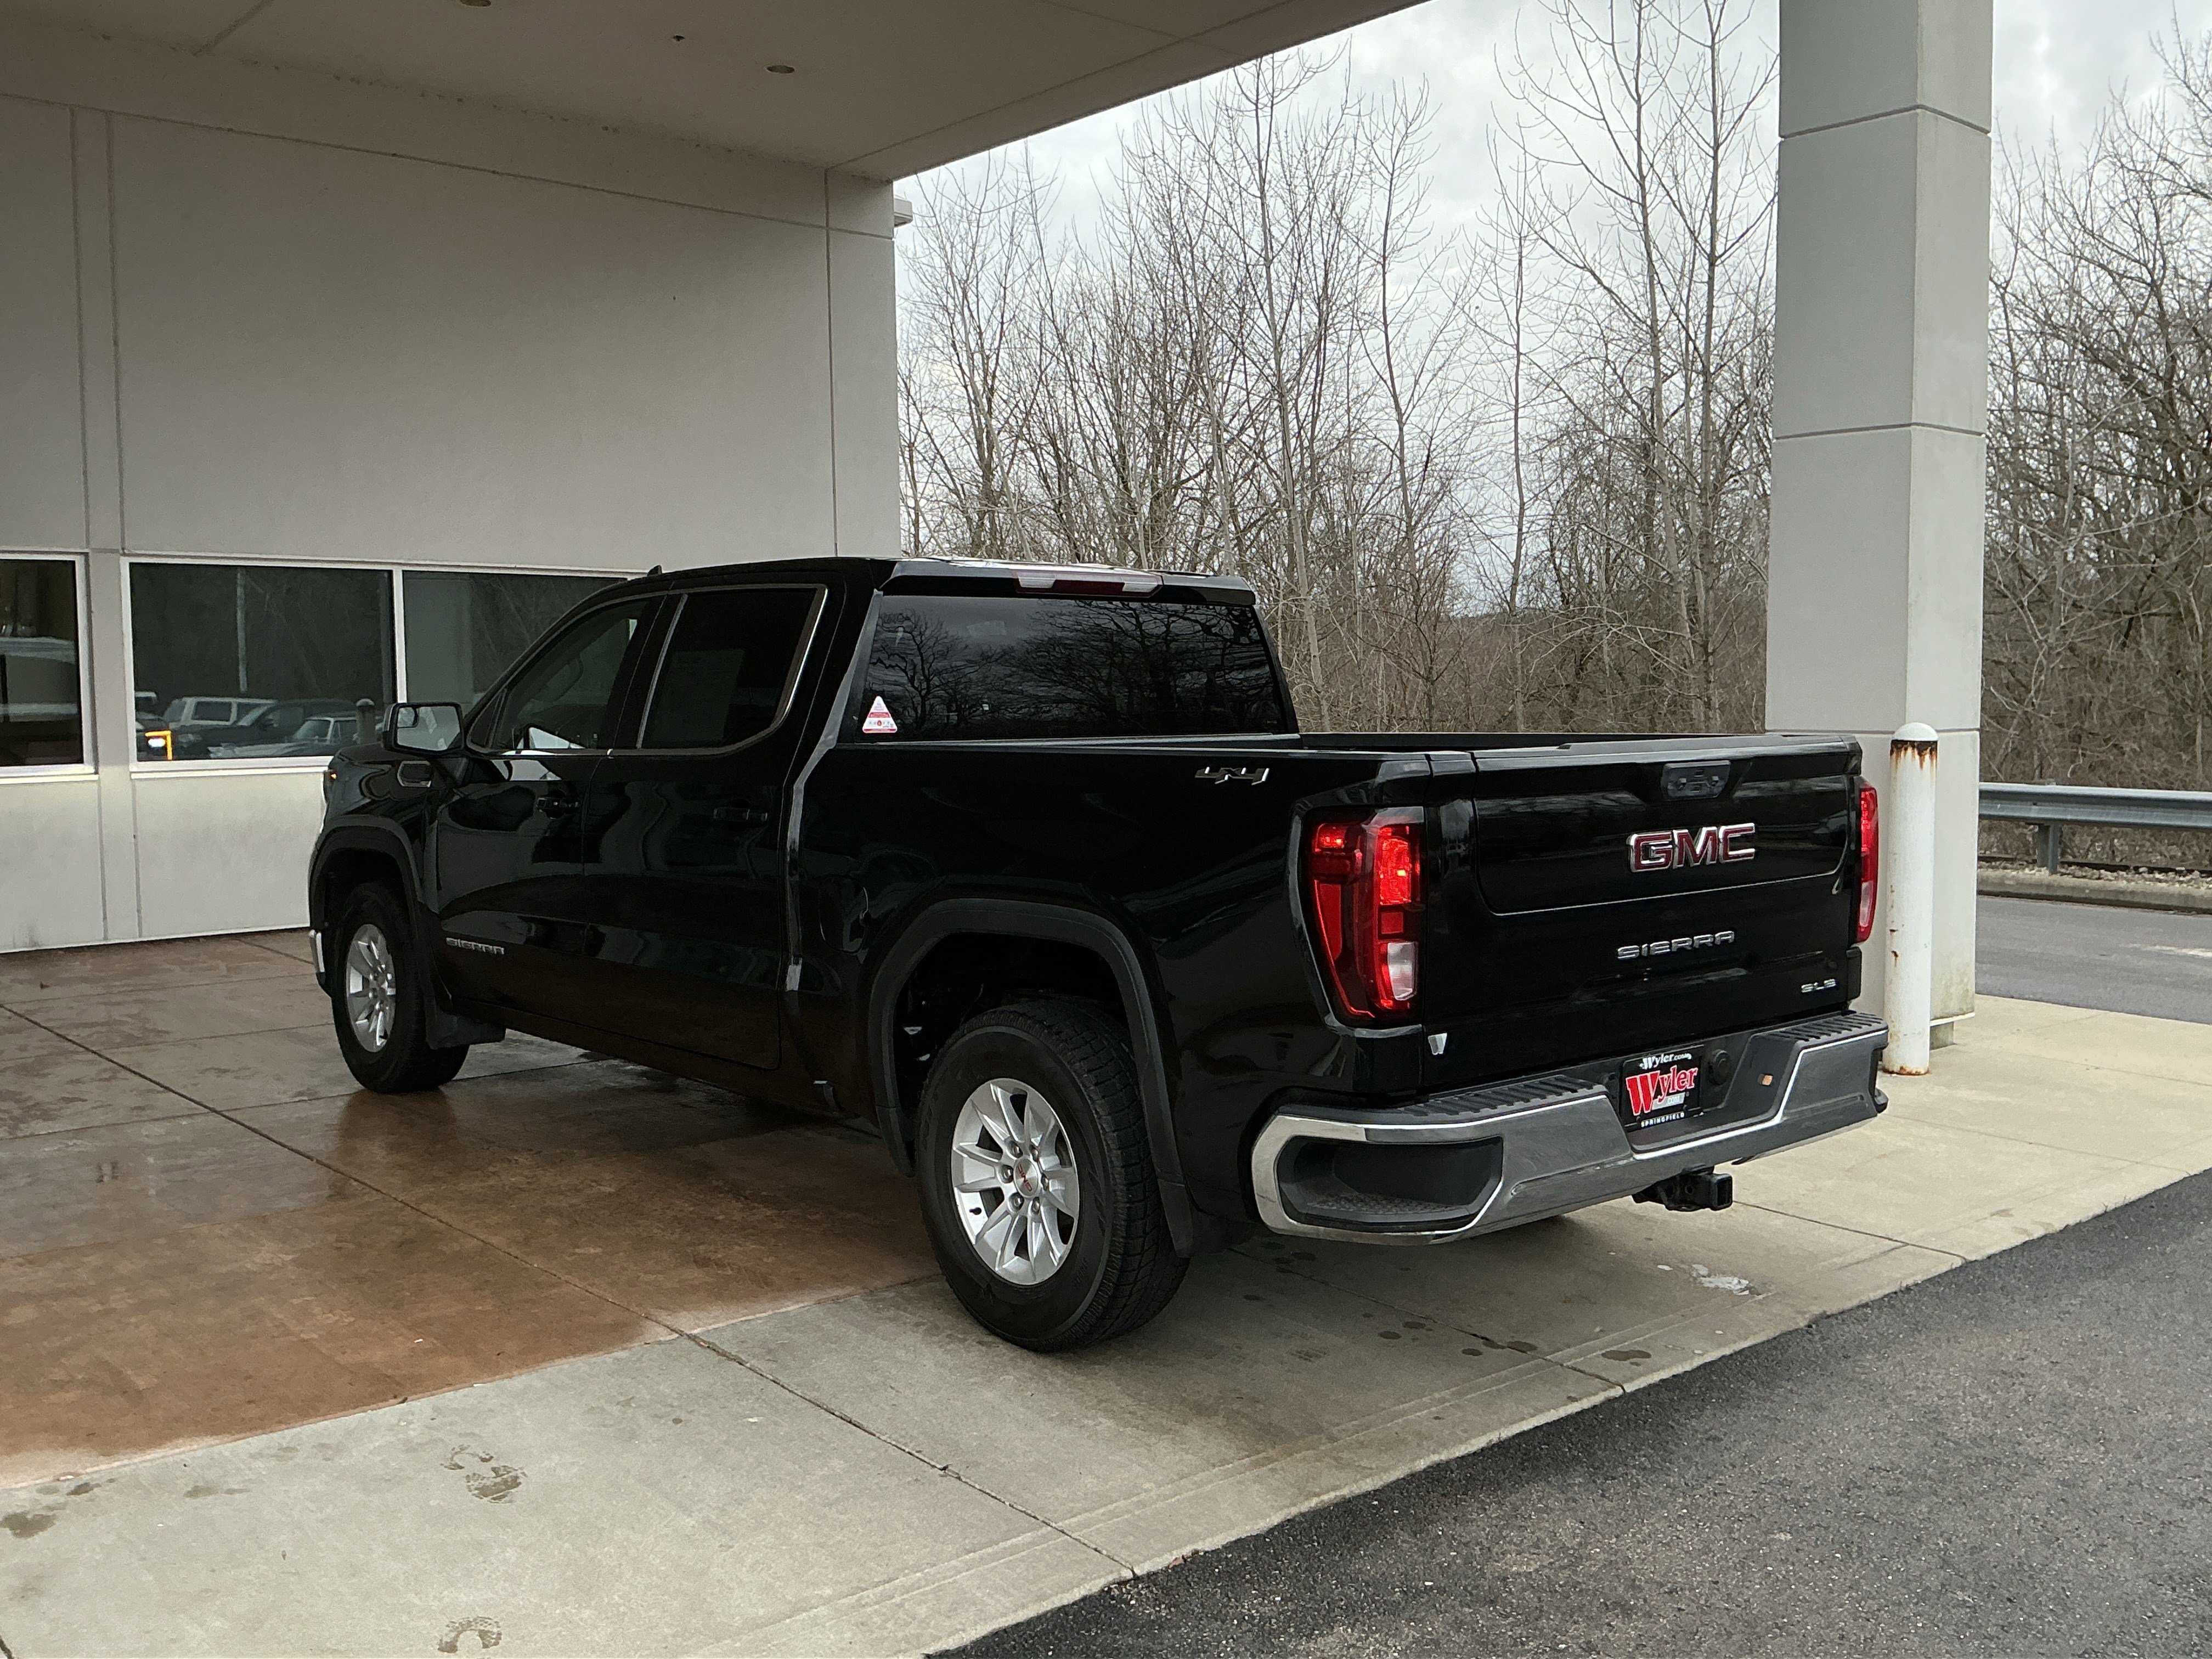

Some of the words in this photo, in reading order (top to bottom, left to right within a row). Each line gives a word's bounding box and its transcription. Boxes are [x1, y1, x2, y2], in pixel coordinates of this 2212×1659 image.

[1627, 822, 1756, 872] GMC
[446, 938, 504, 954] SIERRA
[1617, 930, 1734, 960] SIERRA
[1626, 1065, 1699, 1116] Wyler
[1641, 1112, 1684, 1127] SPRINGFIELD
